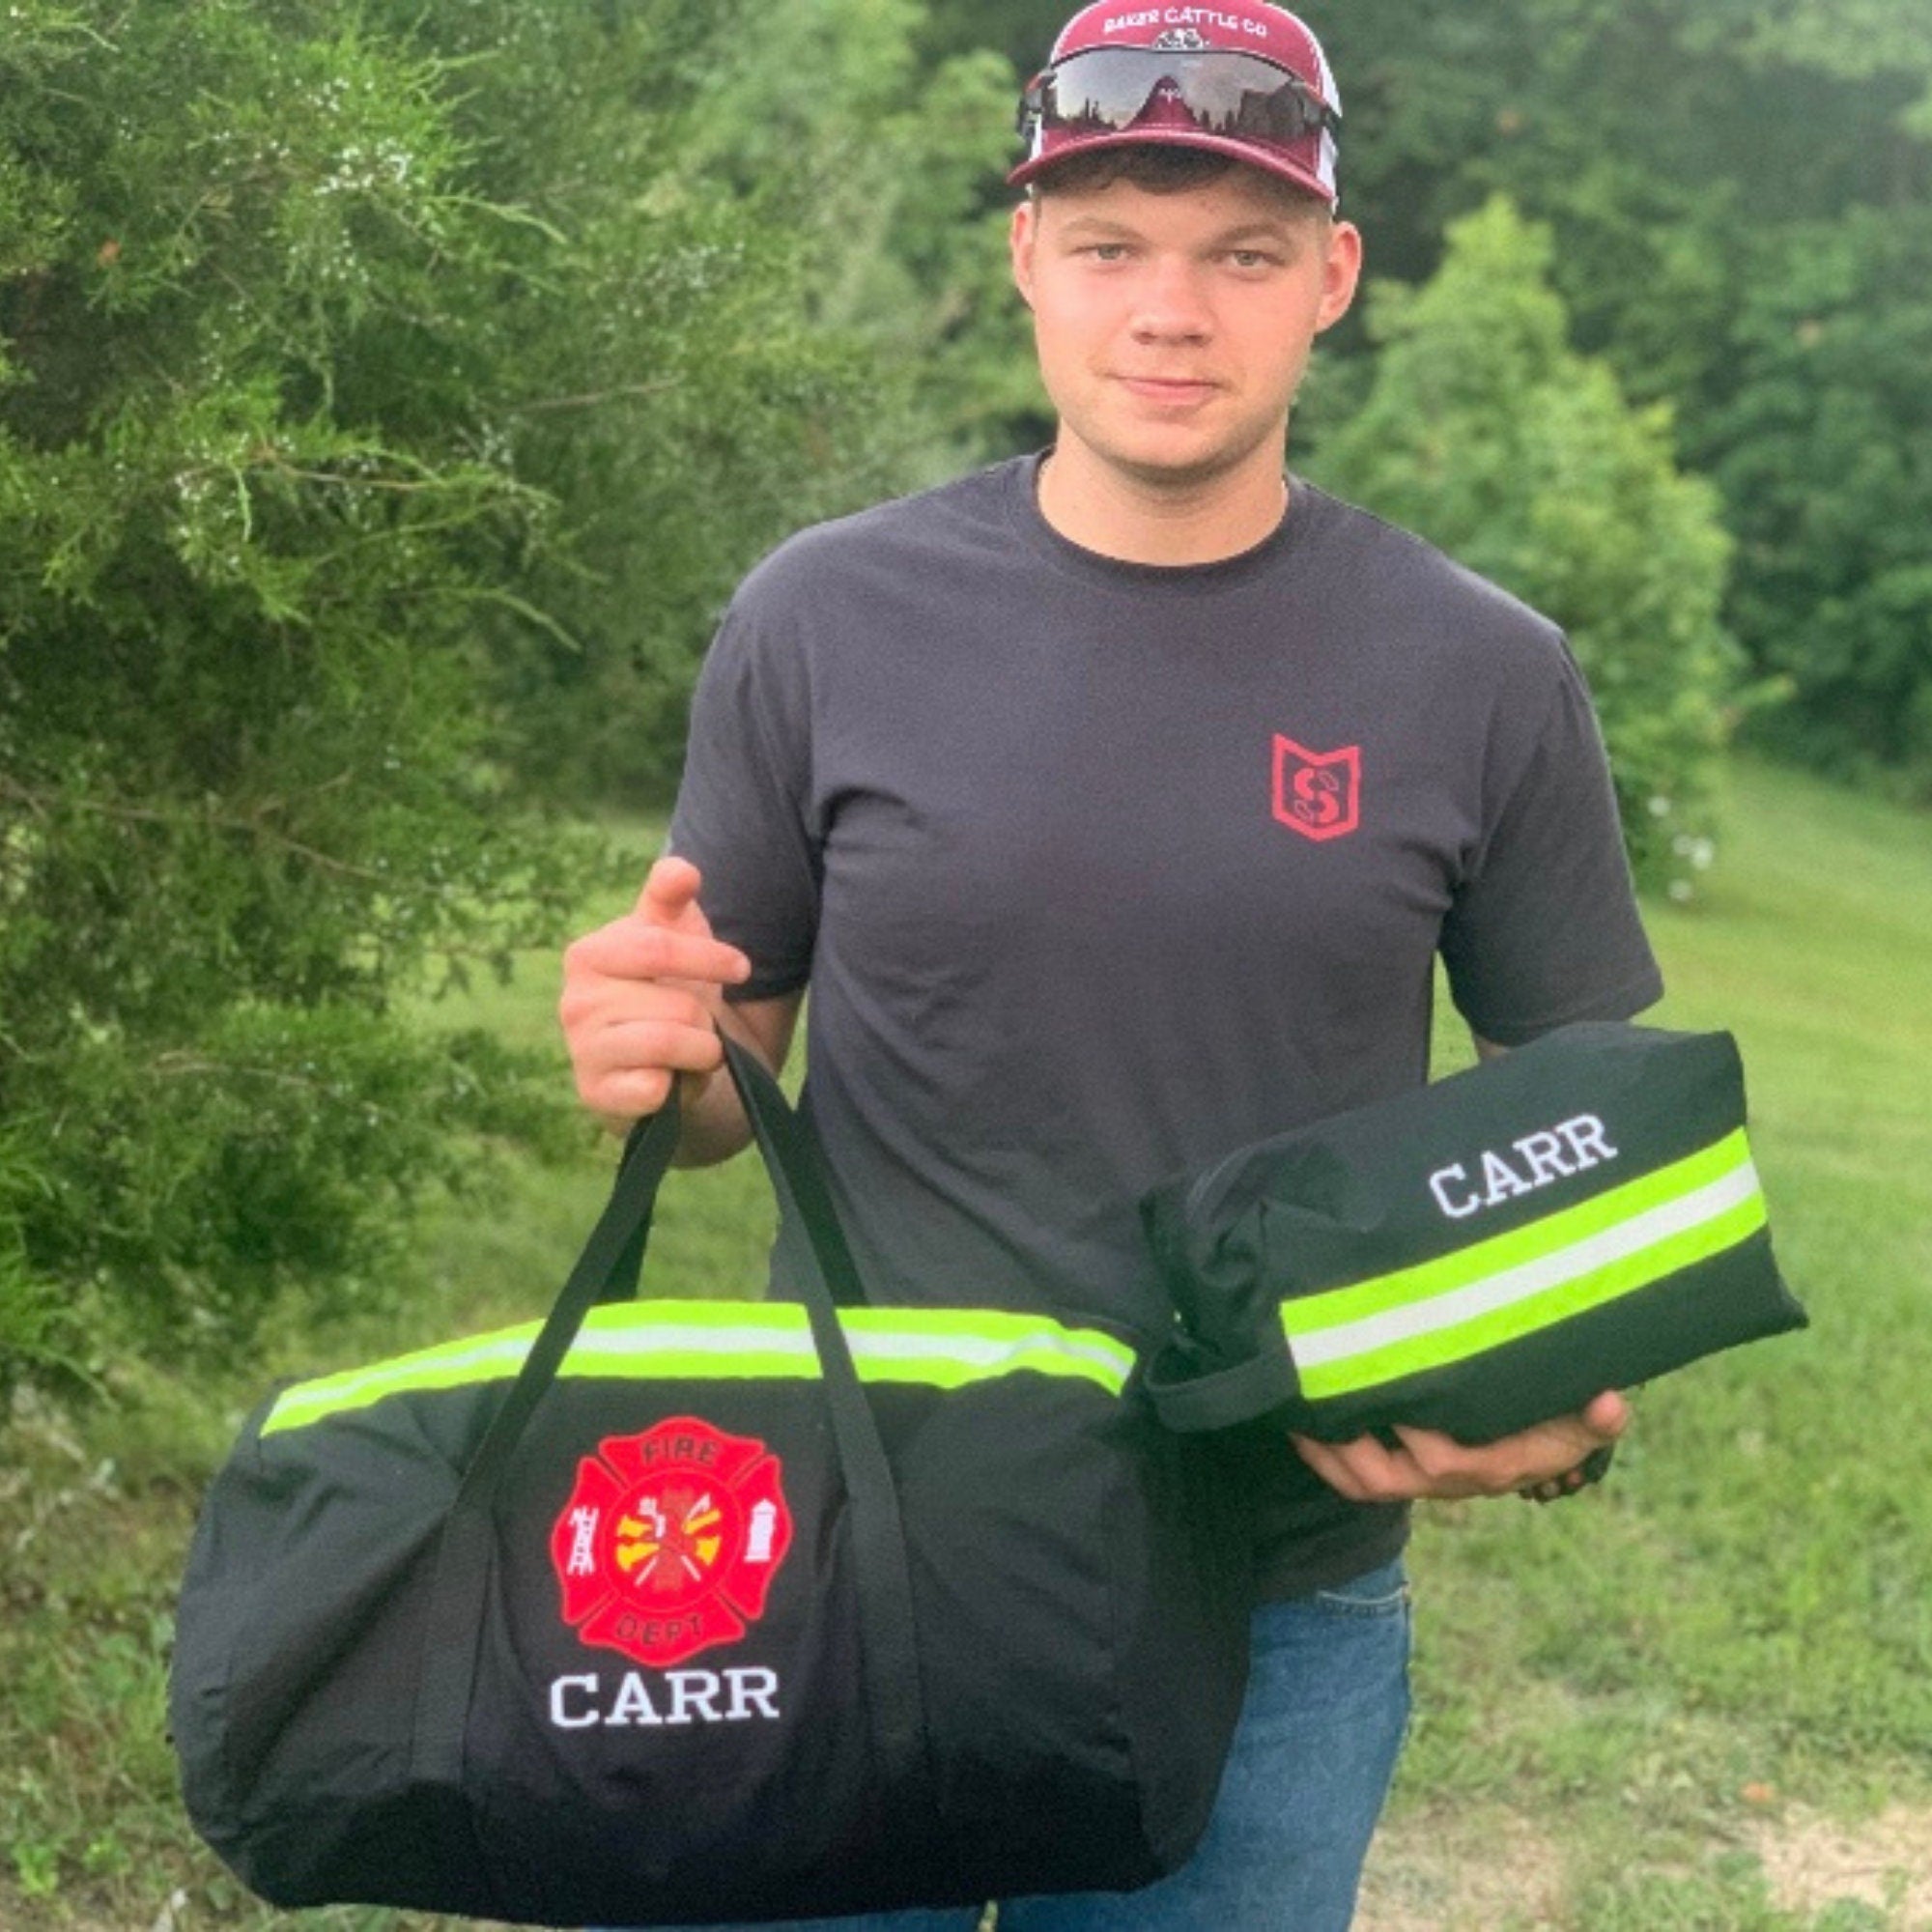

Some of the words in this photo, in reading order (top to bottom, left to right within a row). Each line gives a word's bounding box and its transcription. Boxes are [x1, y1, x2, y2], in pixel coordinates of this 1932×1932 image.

[1103, 9, 1159, 33] BAKER
[1164, 7, 1237, 29] CATTLE
[1243, 19, 1267, 37] CO
[1430, 1114, 1618, 1218] CARR
[642, 1435, 718, 1465] FIRE
[616, 1615, 702, 1646] DEPT
[551, 1666, 780, 1727] CARR
